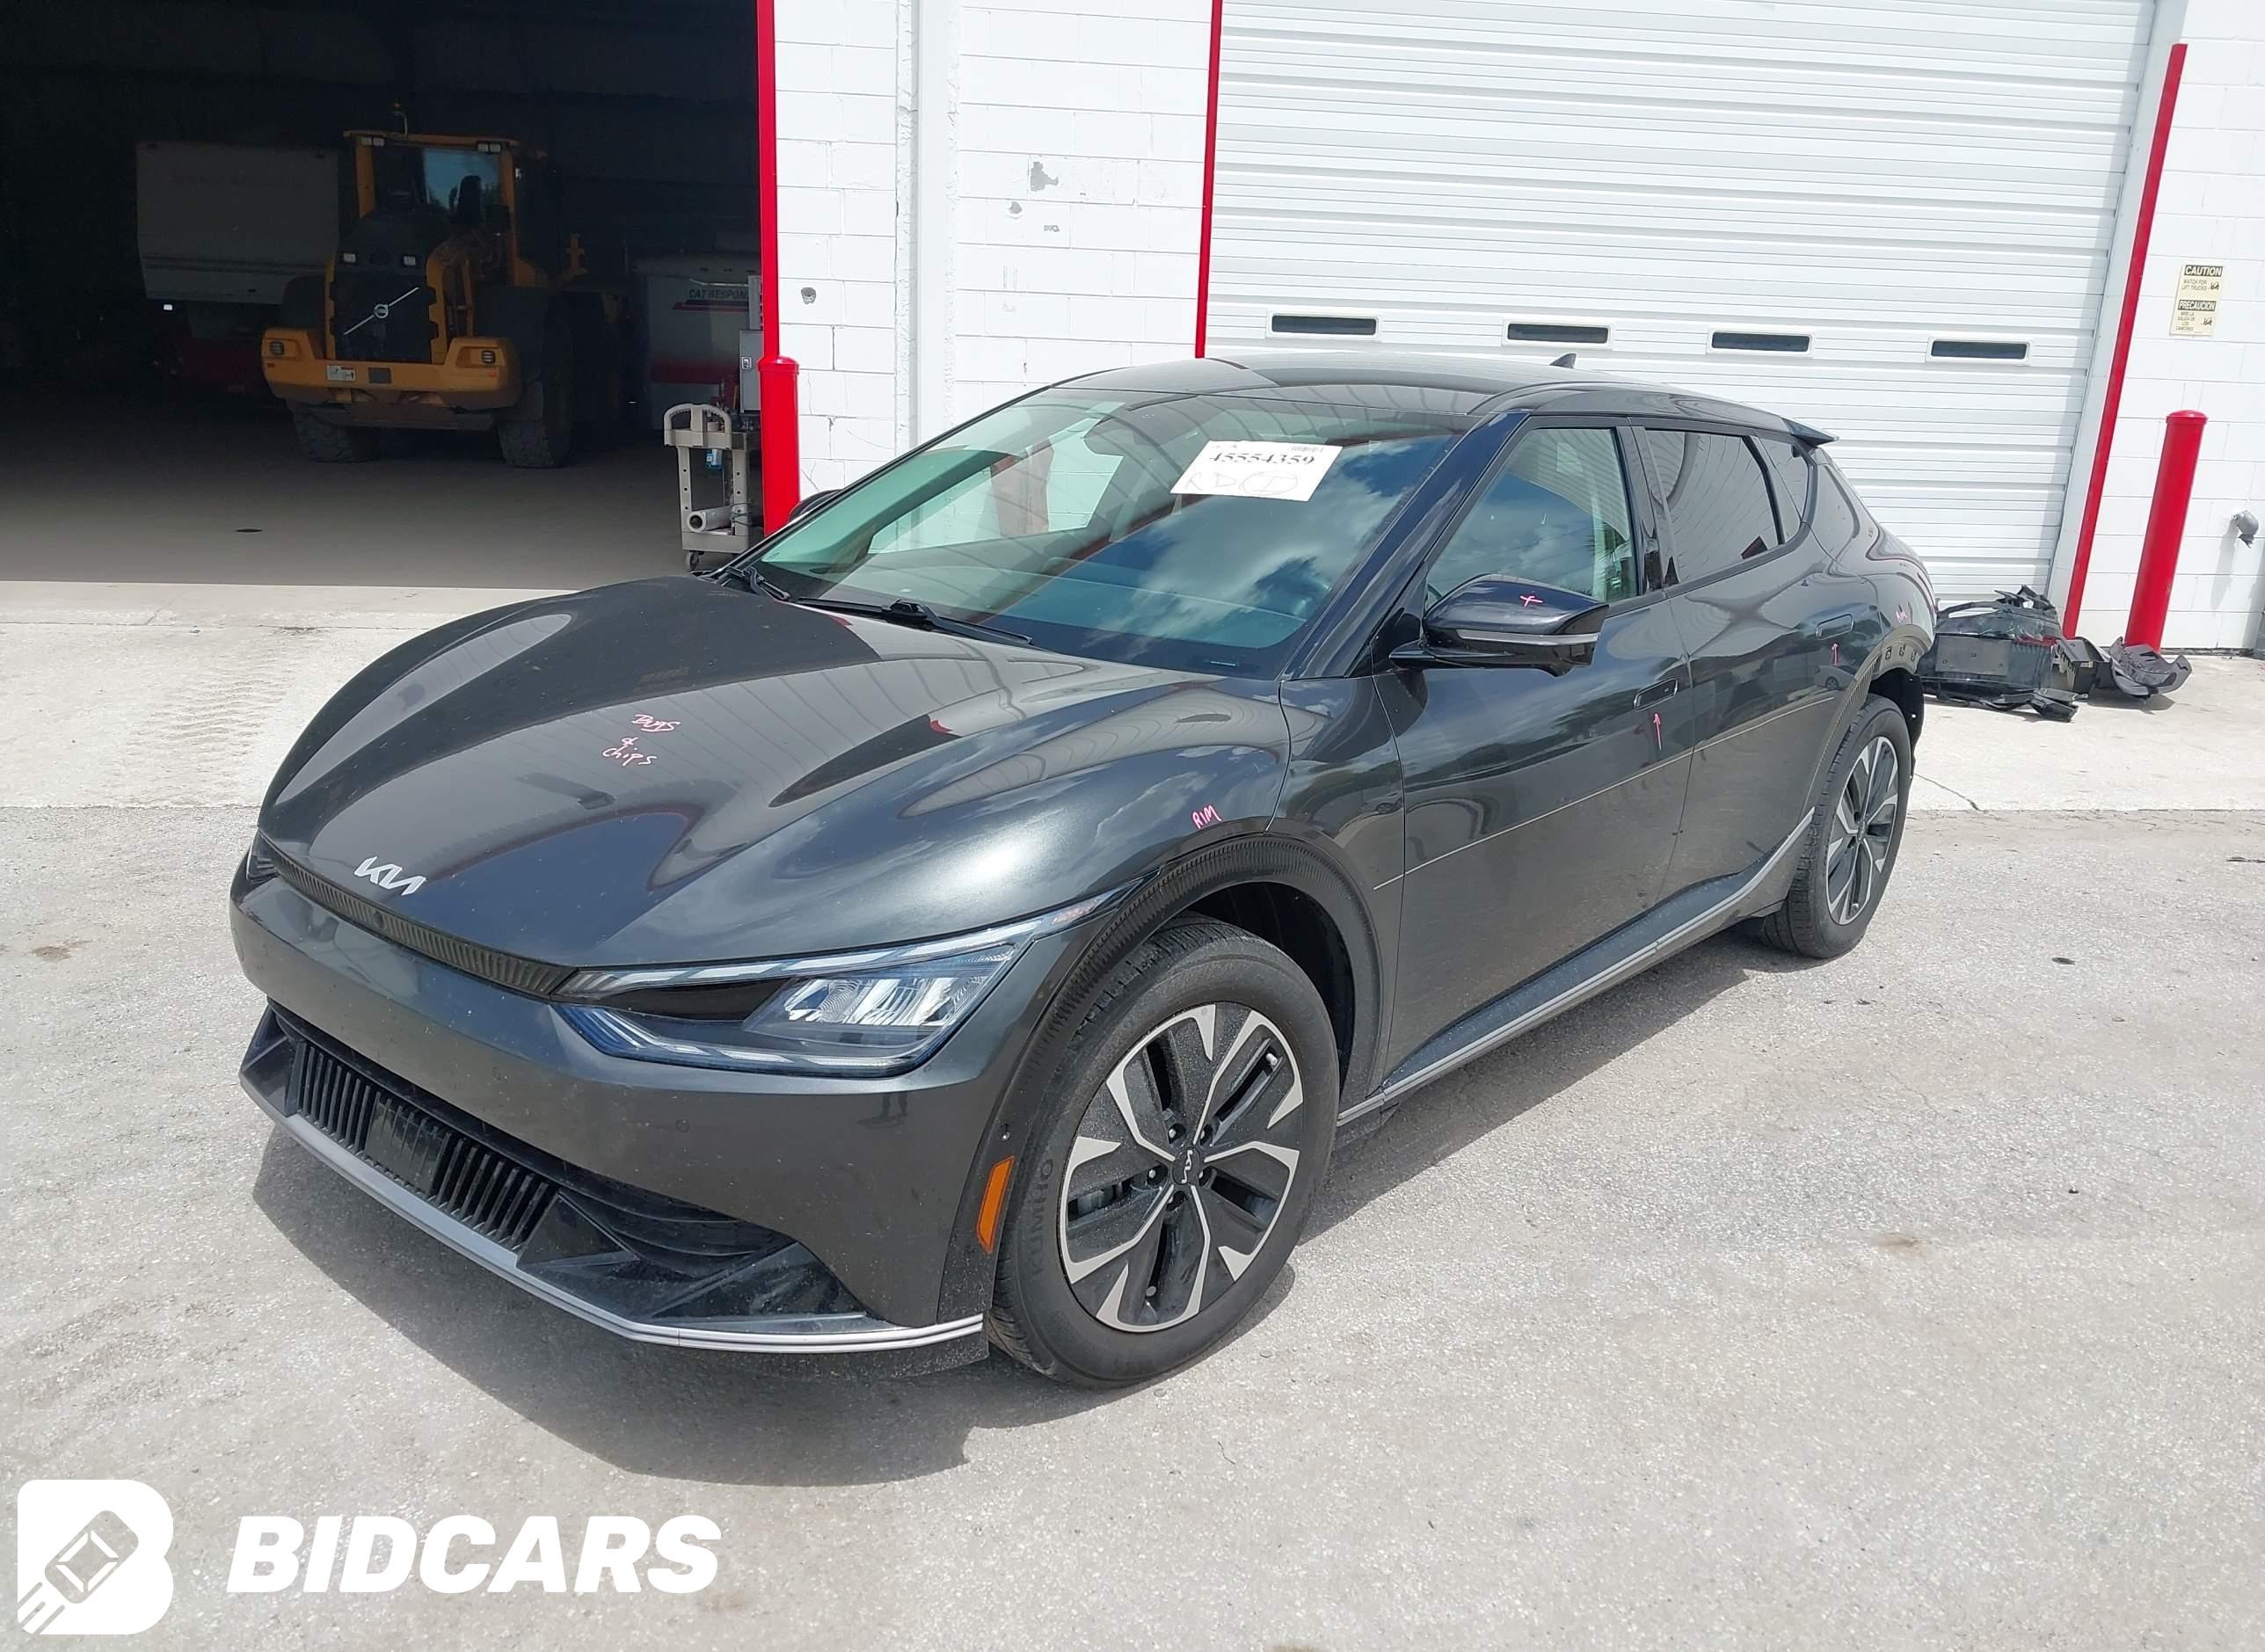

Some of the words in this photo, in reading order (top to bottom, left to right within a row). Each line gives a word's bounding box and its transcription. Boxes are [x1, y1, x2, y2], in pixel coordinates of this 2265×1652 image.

[2185, 266, 2222, 276] CAUTION
[709, 289, 749, 300] RESPON
[2178, 300, 2216, 310] PRECAUCION
[1209, 452, 1316, 465] 45554359
[353, 855, 427, 897] KIA
